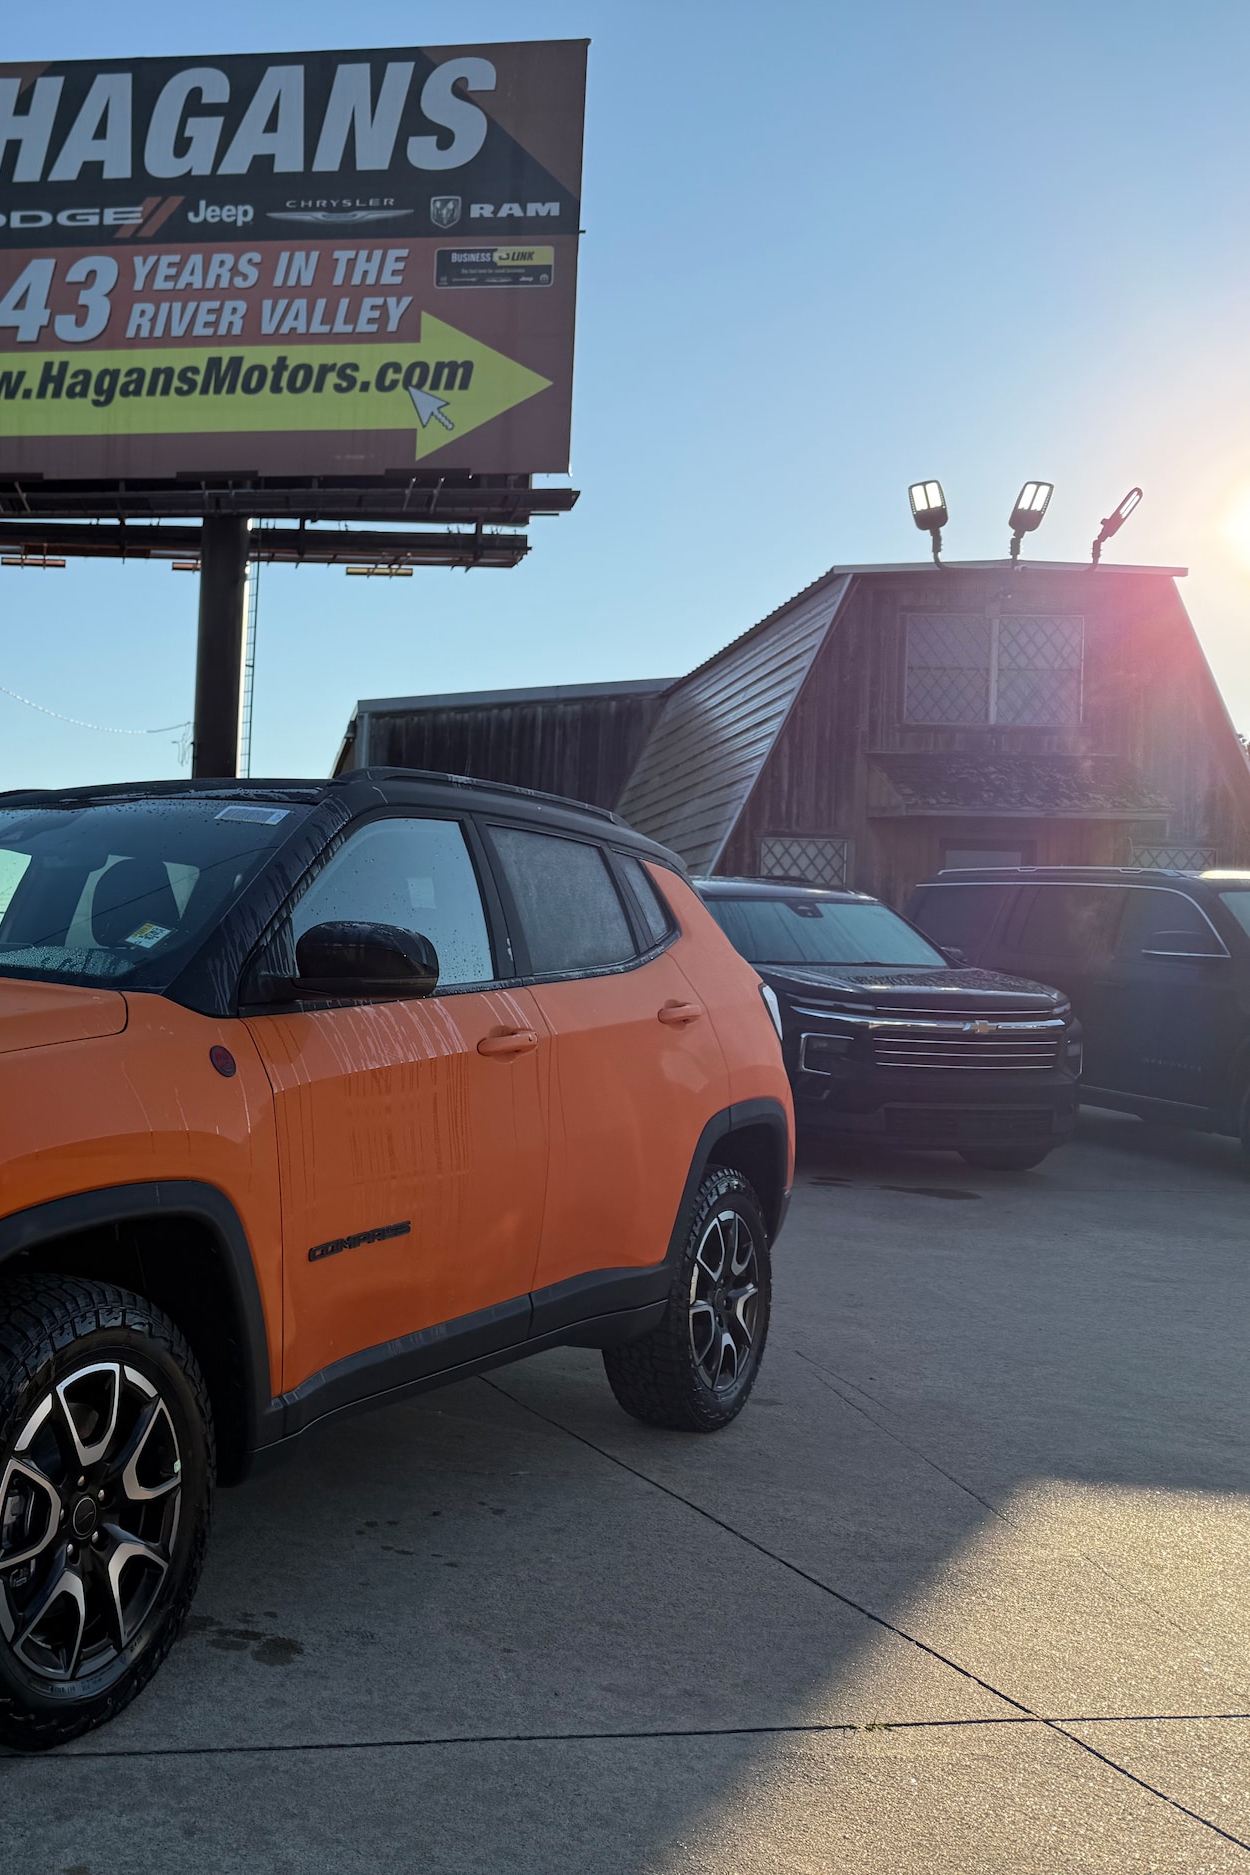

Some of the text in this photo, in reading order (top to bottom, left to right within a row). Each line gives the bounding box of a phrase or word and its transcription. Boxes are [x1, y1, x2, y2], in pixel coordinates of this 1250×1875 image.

[187, 199, 254, 226] Jeep
[285, 197, 395, 209] CHRYSLER
[469, 201, 560, 219] RAM
[132, 251, 261, 291] YEARS
[272, 250, 320, 287] IN
[332, 248, 410, 286] THE
[451, 251, 535, 263] BUSINESS LINK
[125, 296, 414, 339] RIVER VALLEY
[308, 1220, 411, 1262] COMPASS
